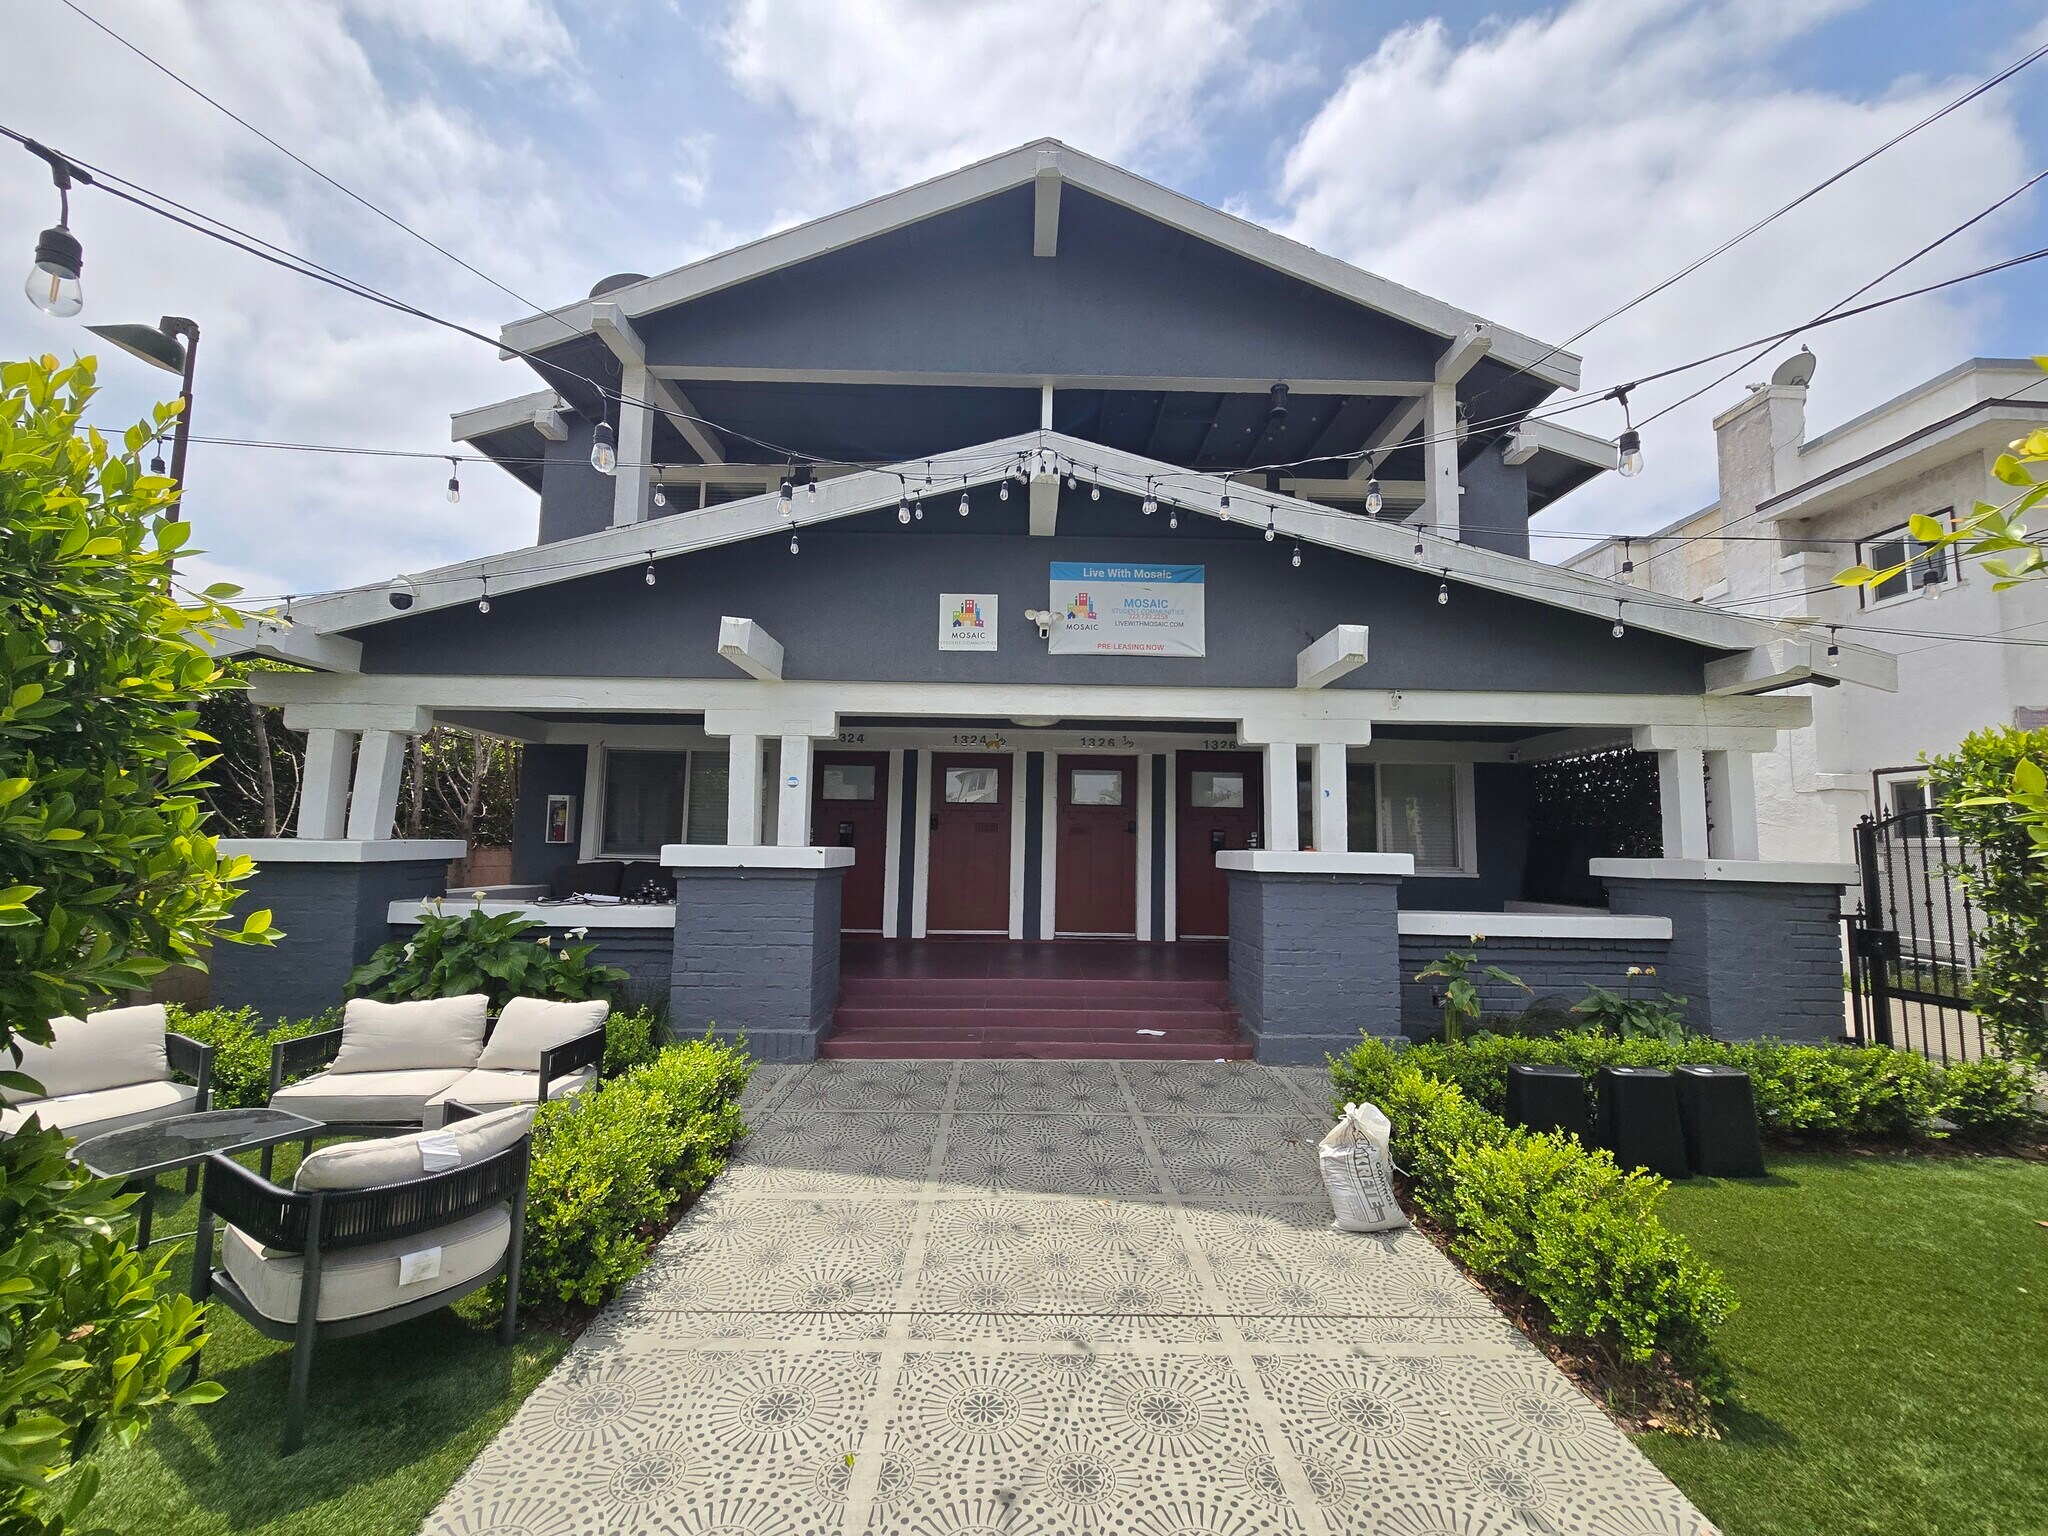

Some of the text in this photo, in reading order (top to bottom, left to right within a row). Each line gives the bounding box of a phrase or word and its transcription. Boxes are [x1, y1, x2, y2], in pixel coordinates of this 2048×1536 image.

[1083, 567, 1172, 579] Live With Mosaic
[1124, 598, 1169, 609] MOSAIC
[1066, 623, 1099, 631] MOSAIC
[1114, 620, 1185, 628] LIVEWITHMOSAIC.COM
[834, 733, 865, 744] 324
[952, 734, 987, 744] 1324
[1080, 736, 1115, 747] 1326
[1203, 740, 1236, 750] 1326
[1376, 1161, 1393, 1208] CONTROL
